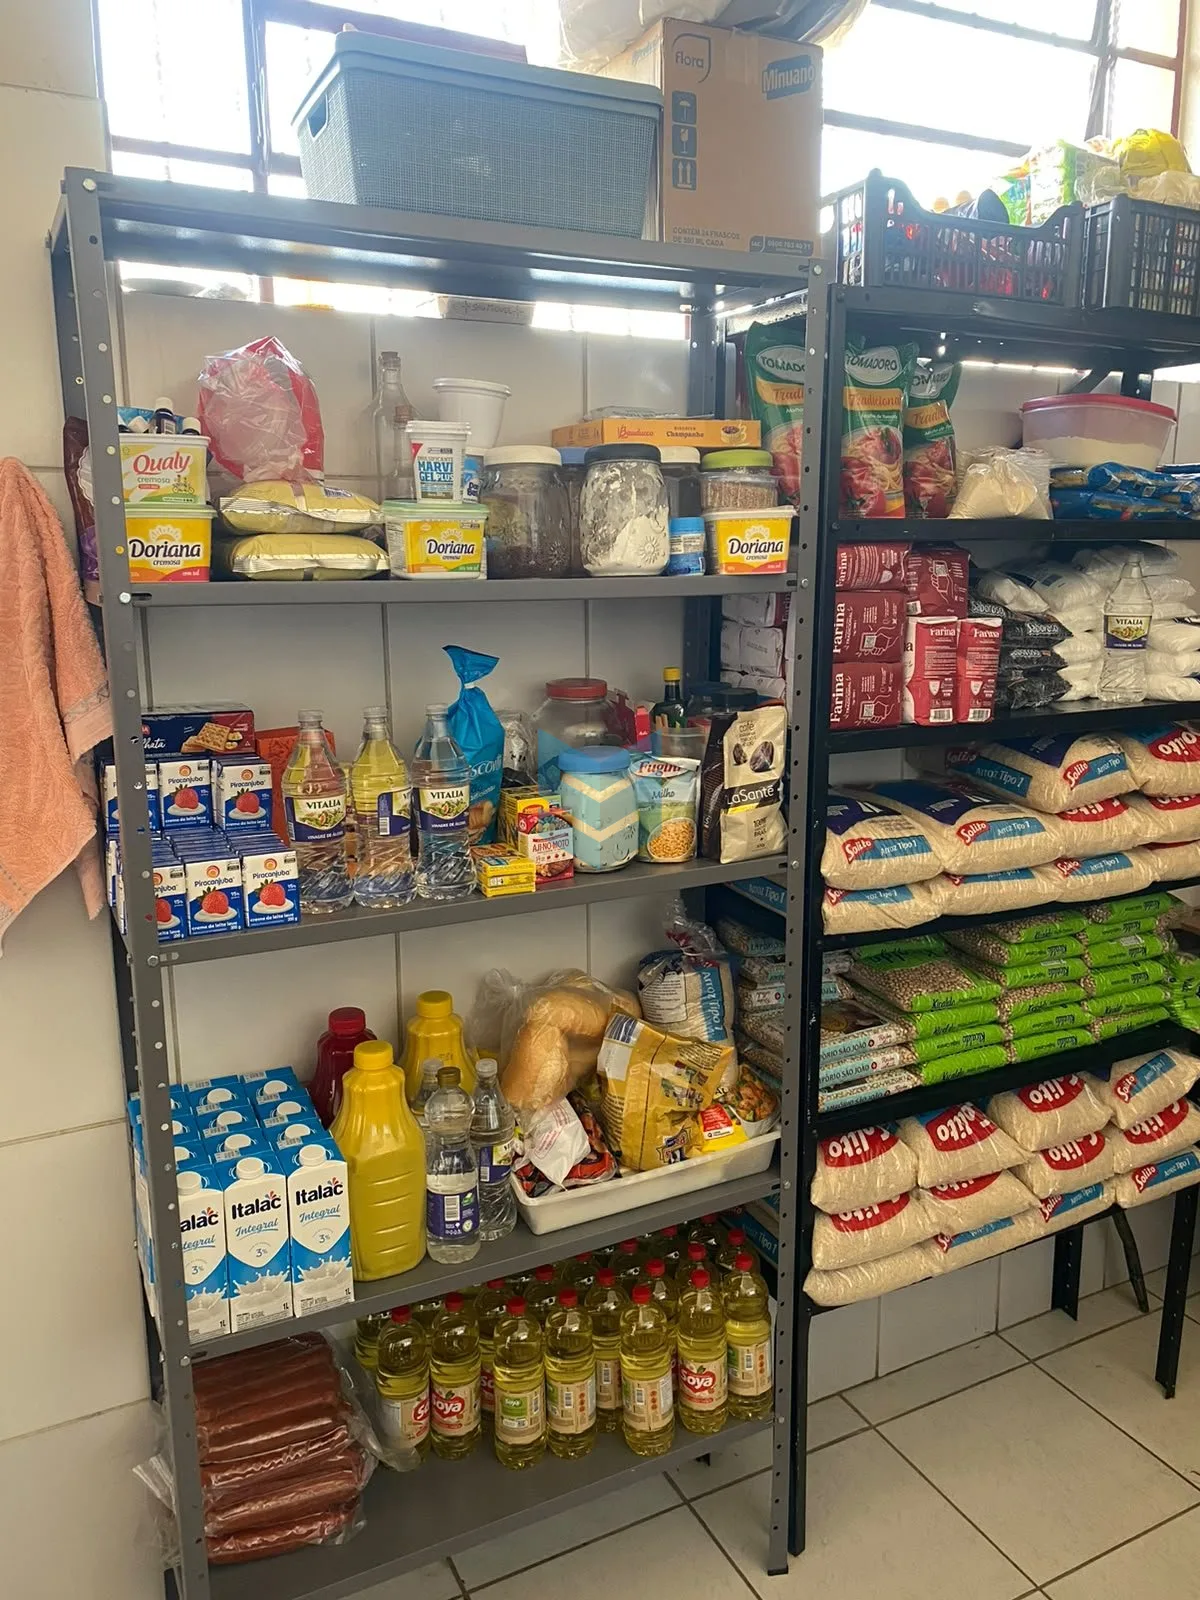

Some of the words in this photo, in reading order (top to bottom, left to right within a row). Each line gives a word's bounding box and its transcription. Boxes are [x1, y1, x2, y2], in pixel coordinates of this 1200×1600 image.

[675, 51, 704, 69] flora
[761, 64, 815, 93] Minuano
[846, 355, 898, 371] TOMADORO
[133, 452, 191, 475] Qualy
[137, 476, 171, 484] cremosa
[129, 539, 201, 558] Doriana
[427, 539, 475, 554] Doriana
[729, 538, 784, 554] Doriana
[153, 558, 181, 566] cremosa
[836, 551, 848, 588] Farina
[833, 603, 846, 654] Farina
[1115, 618, 1143, 626] VITALIA
[930, 627, 956, 636] Farina
[830, 673, 845, 723] Farina
[168, 776, 204, 784] Piracanjuba
[976, 766, 997, 777] Arroz
[999, 770, 1017, 785] Tipo
[1017, 776, 1025, 787] 1
[1067, 762, 1088, 788] Solito
[231, 780, 264, 788] Piracanjuba
[431, 790, 464, 799] VITALIA
[652, 787, 675, 800] Milho
[727, 784, 774, 805] LaSanté
[306, 799, 341, 810] VITALIA
[960, 822, 987, 844] Solito
[1013, 822, 1026, 832] Tipo
[844, 840, 872, 861] Solito
[897, 841, 912, 851] Tipo
[253, 870, 290, 879] Piracanjuba
[194, 878, 233, 887] Piracanjuba
[765, 886, 780, 902] Tipo
[702, 971, 717, 998] Arroz
[710, 999, 721, 1023] Tipo
[838, 1044, 851, 1055] SÃO
[852, 1041, 867, 1051] JOÃO
[842, 1067, 854, 1078] SÃO
[854, 1064, 870, 1074] JOÃO
[1176, 1162, 1187, 1171] Tipo
[1136, 1166, 1156, 1190] Solito
[295, 1182, 344, 1205] Italac
[231, 1195, 282, 1220] Italac
[300, 1205, 341, 1222] Integral
[235, 1218, 279, 1237] Integral
[319, 1233, 331, 1244] 3%
[255, 1247, 268, 1258] 3%
[191, 1264, 204, 1275] 3%
[345, 1287, 351, 1295] 1L
[283, 1302, 289, 1310] 1L
[220, 1320, 226, 1328] 1L
[681, 1370, 713, 1388] Soya
